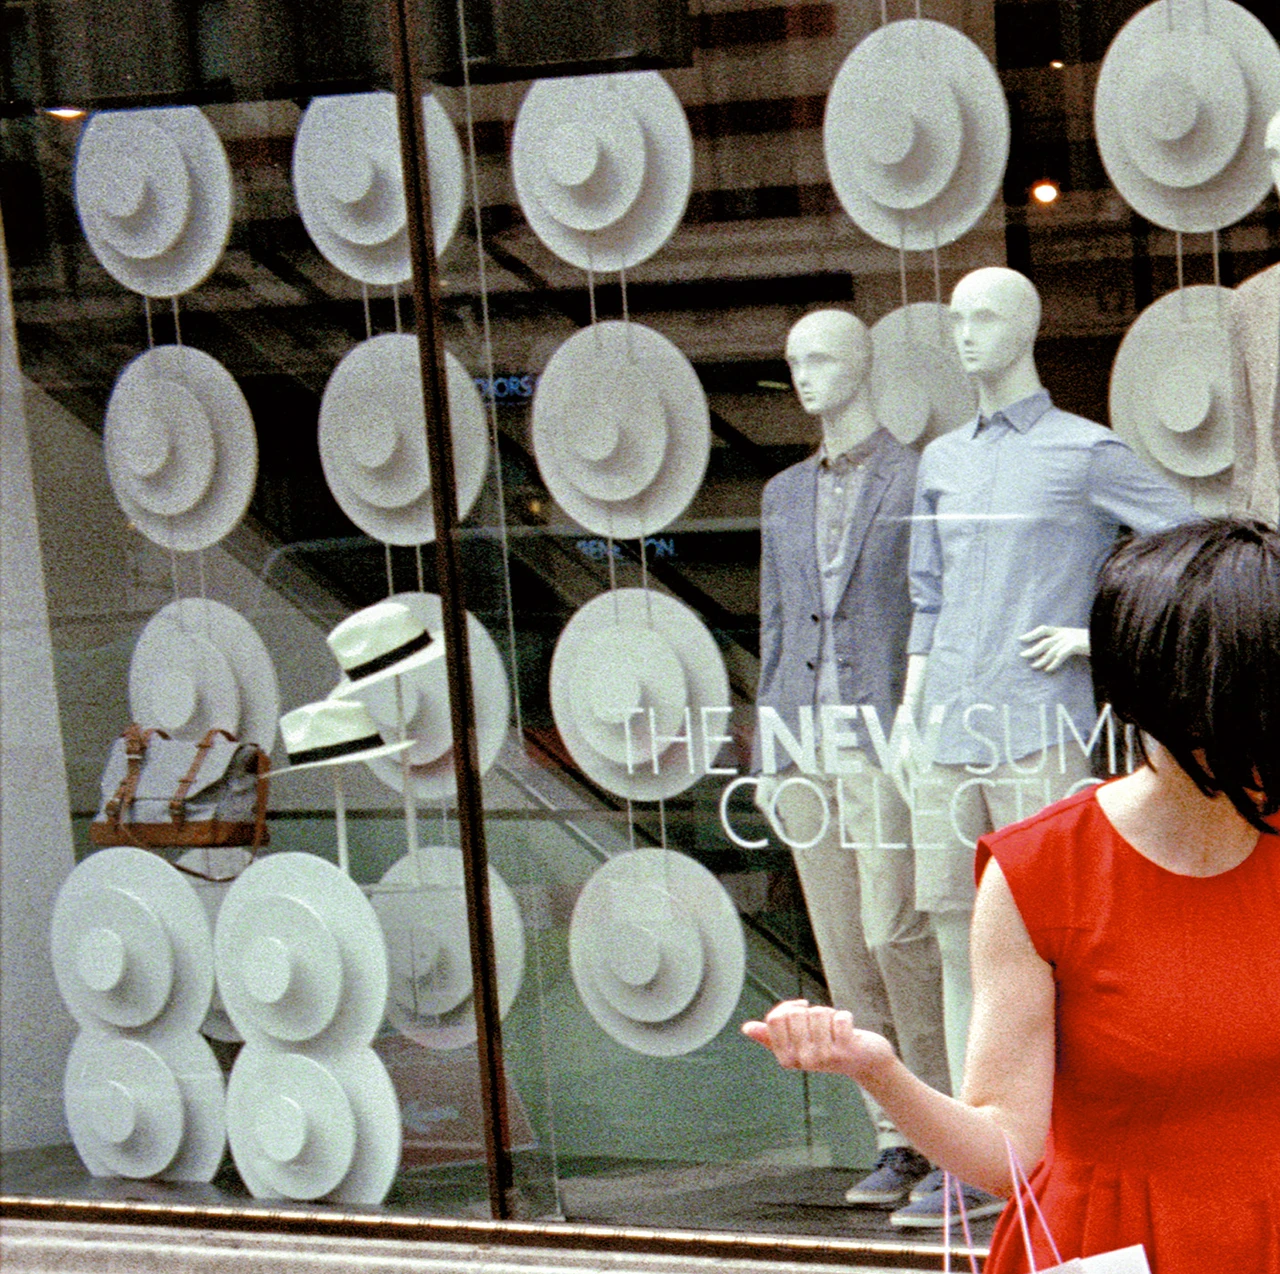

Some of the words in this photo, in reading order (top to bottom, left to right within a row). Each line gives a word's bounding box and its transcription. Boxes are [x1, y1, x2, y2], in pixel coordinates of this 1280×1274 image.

[610, 706, 738, 774] THE
[758, 704, 946, 774] NEW
[964, 703, 1136, 774] SUM
